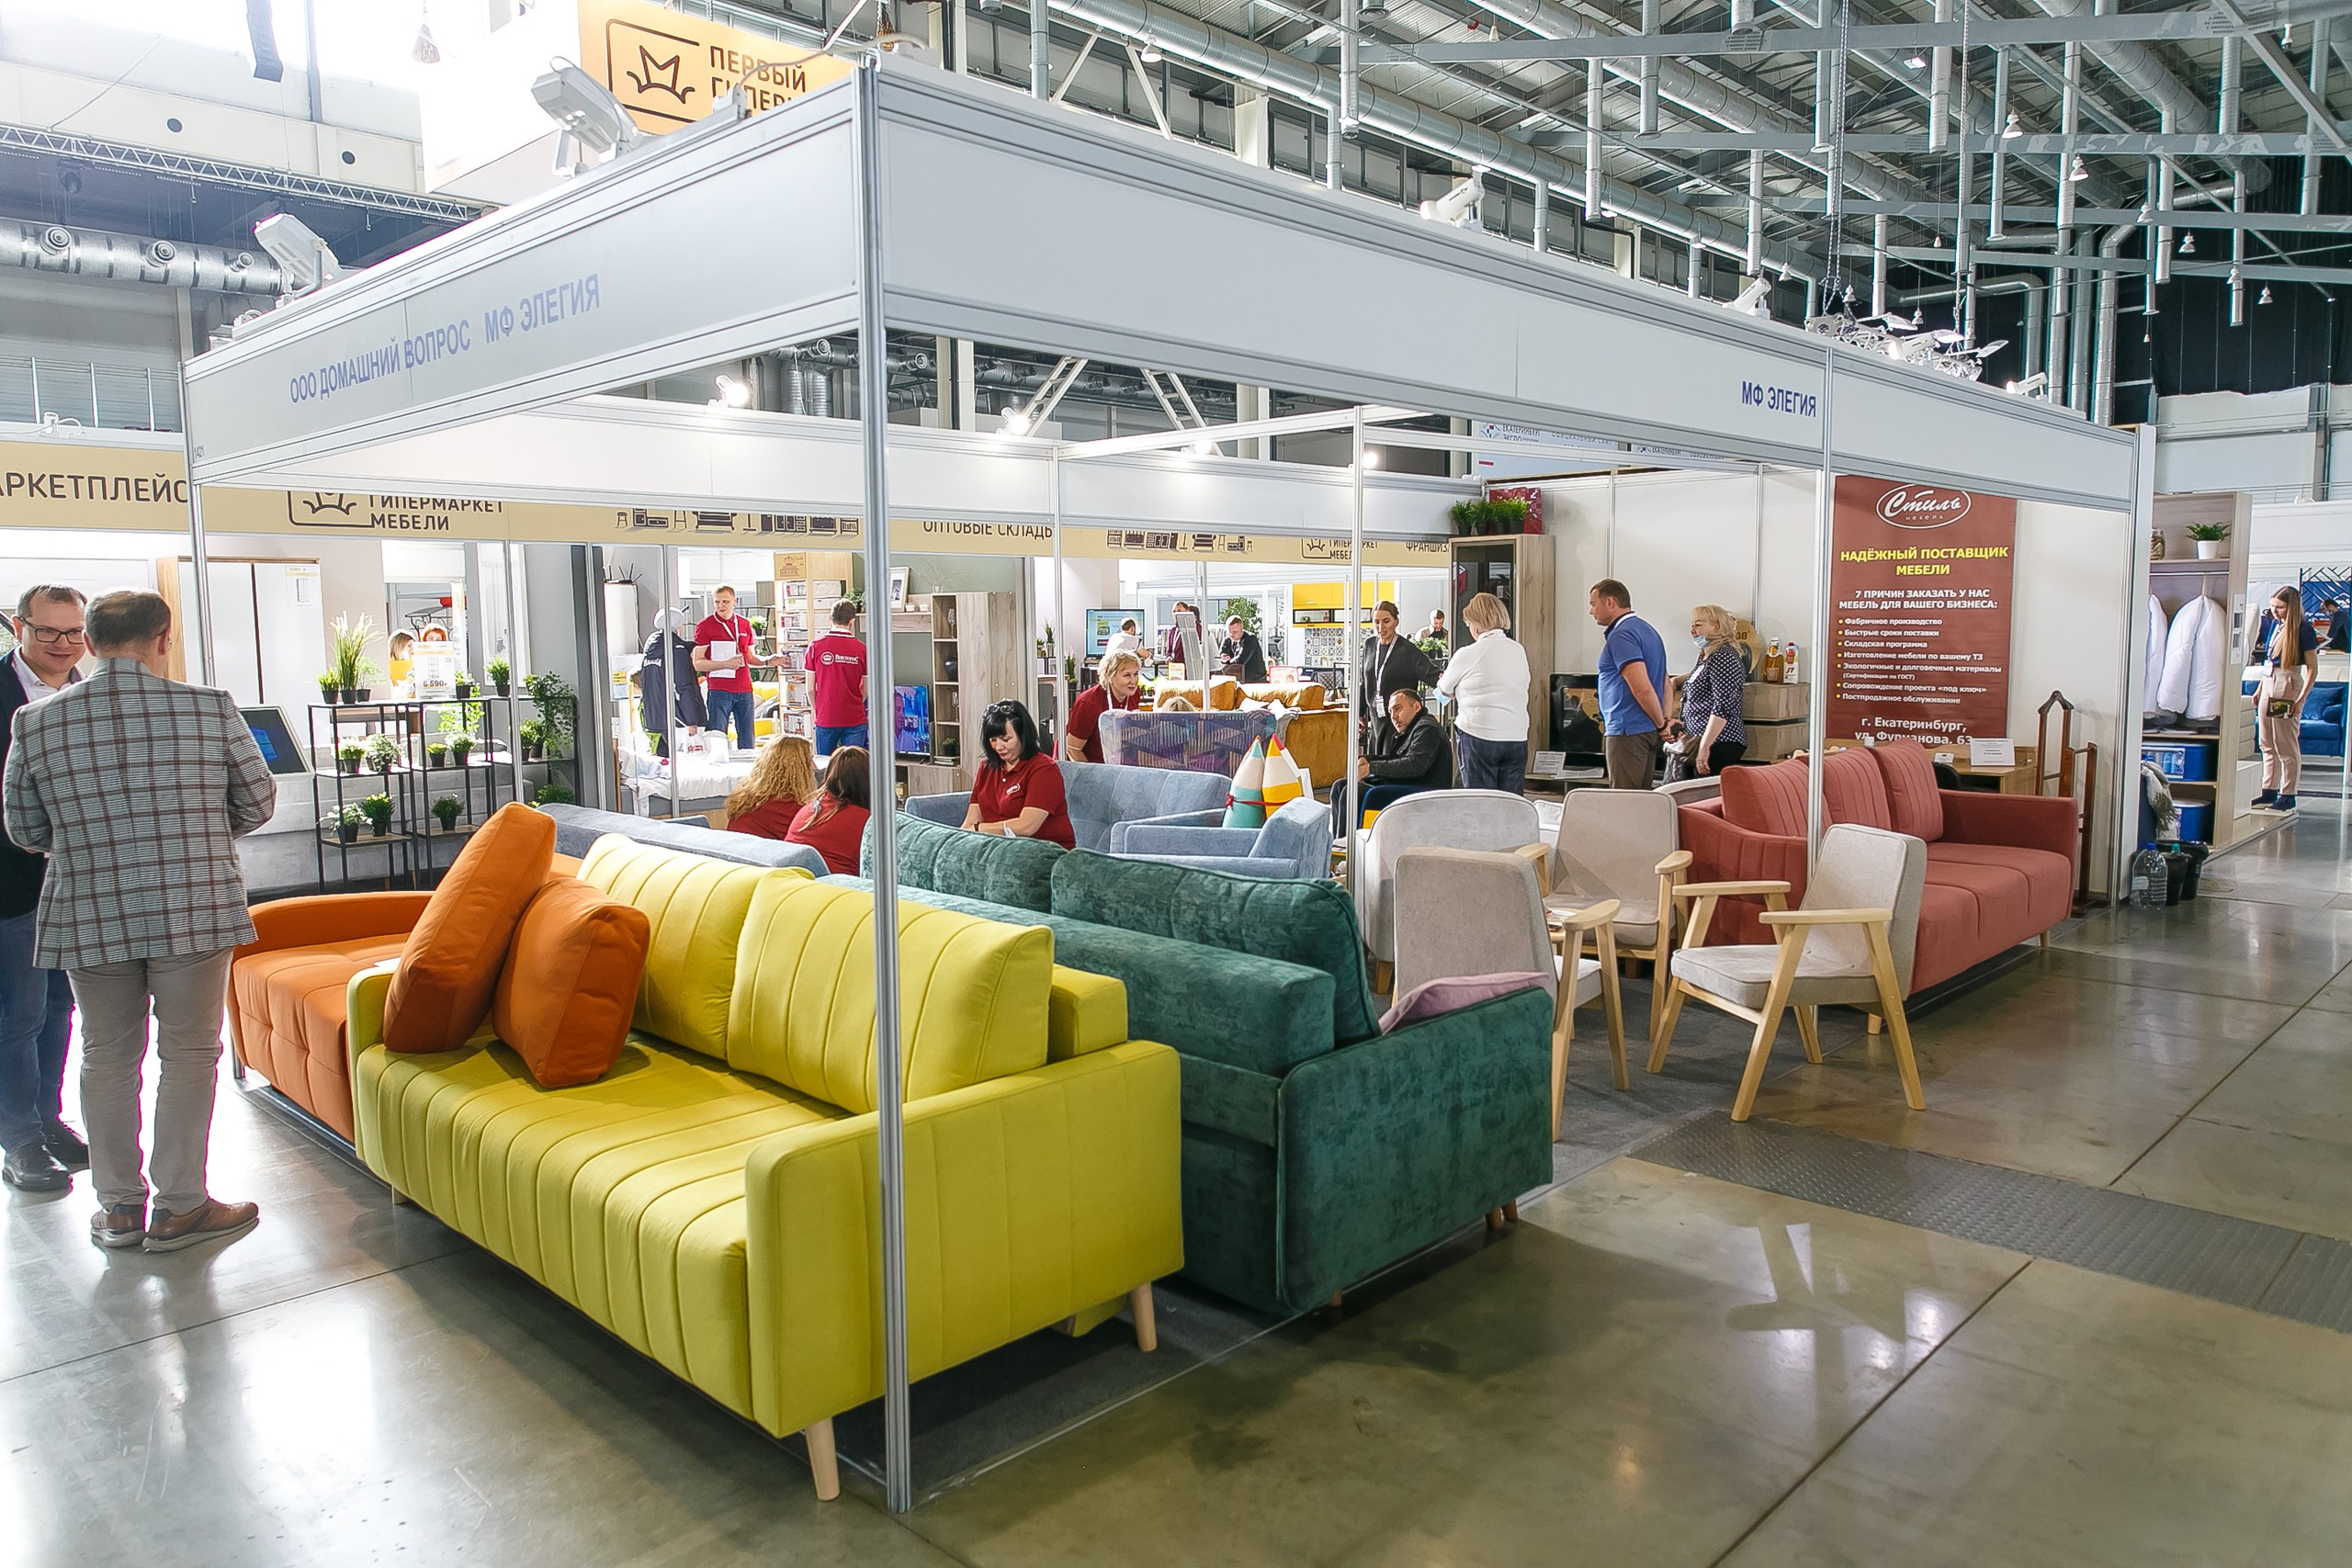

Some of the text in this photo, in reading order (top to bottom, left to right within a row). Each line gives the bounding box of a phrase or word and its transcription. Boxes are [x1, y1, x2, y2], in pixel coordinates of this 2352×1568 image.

[710, 45, 807, 93] ПЕРВЫЙ
[290, 273, 600, 404] ООО ДОМАШНИЙ ВОПРОС МФ ЭЛЕГИЯ
[1742, 380, 1816, 418] МФ ЭЛЕГИЯ
[369, 494, 503, 513] ГИПЕРМАРКЕТ
[1883, 490, 1962, 518] Стиль
[370, 513, 449, 531] МЕБЕЛИ
[1840, 547, 2009, 562] НАДЁЖНЫЙ ПОСТАВЩИК
[1895, 564, 1951, 576] МЕБЕЛИ
[1855, 589, 1990, 598] 7 ПРИЧИН ЗАКАЗАТЬ У НАС
[1838, 600, 1998, 610] МЕБЕЛЬ ДЛЯ ВАШЕГО БИЗНЕСА:
[1842, 682, 1904, 691] Сопровождение
[1842, 693, 1961, 704] Постпродажное обслуживание
[1860, 716, 1967, 733] г. Екатеринбург,
